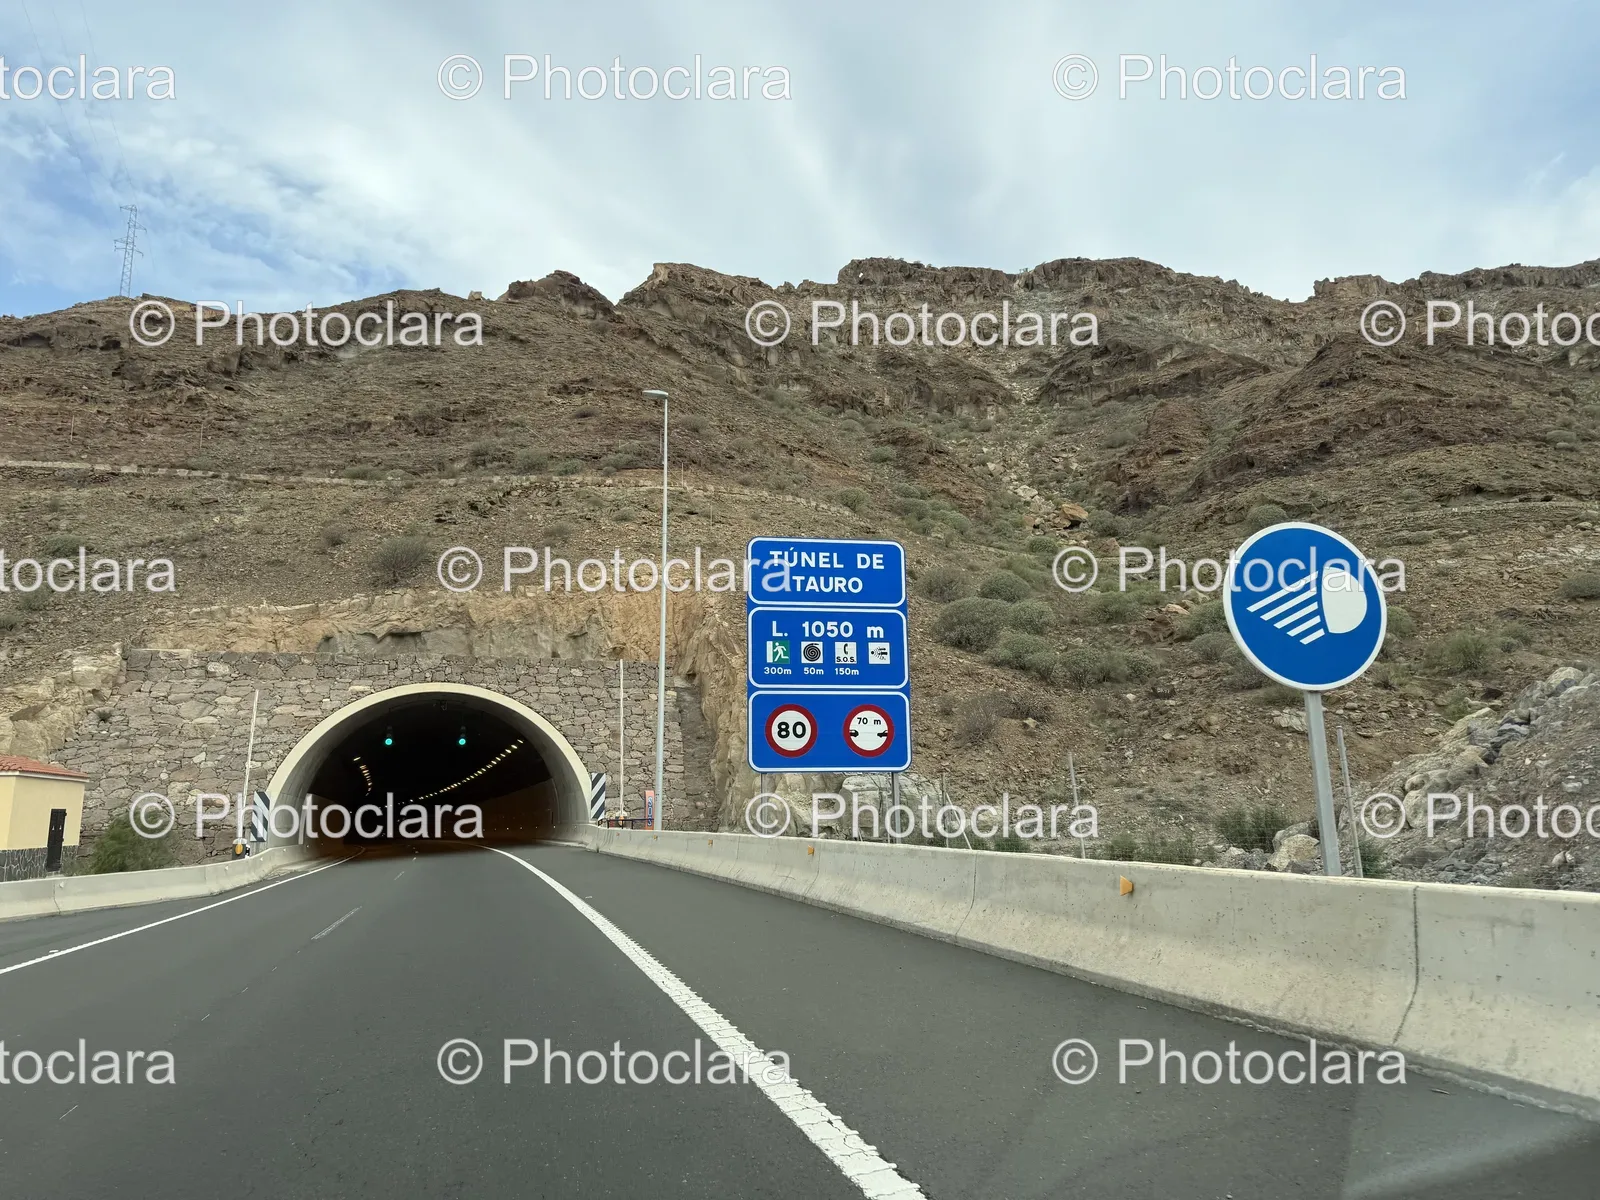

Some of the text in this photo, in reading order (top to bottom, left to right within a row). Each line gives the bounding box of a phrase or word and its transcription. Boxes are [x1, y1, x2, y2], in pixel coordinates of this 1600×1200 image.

[770, 547, 884, 570] TÚNEL DE
[792, 576, 863, 593] TAURO
[772, 620, 884, 638] L. 1050 m
[764, 667, 859, 676] 300m 50m 150m
[857, 717, 868, 725] 70
[777, 721, 806, 739] 80
